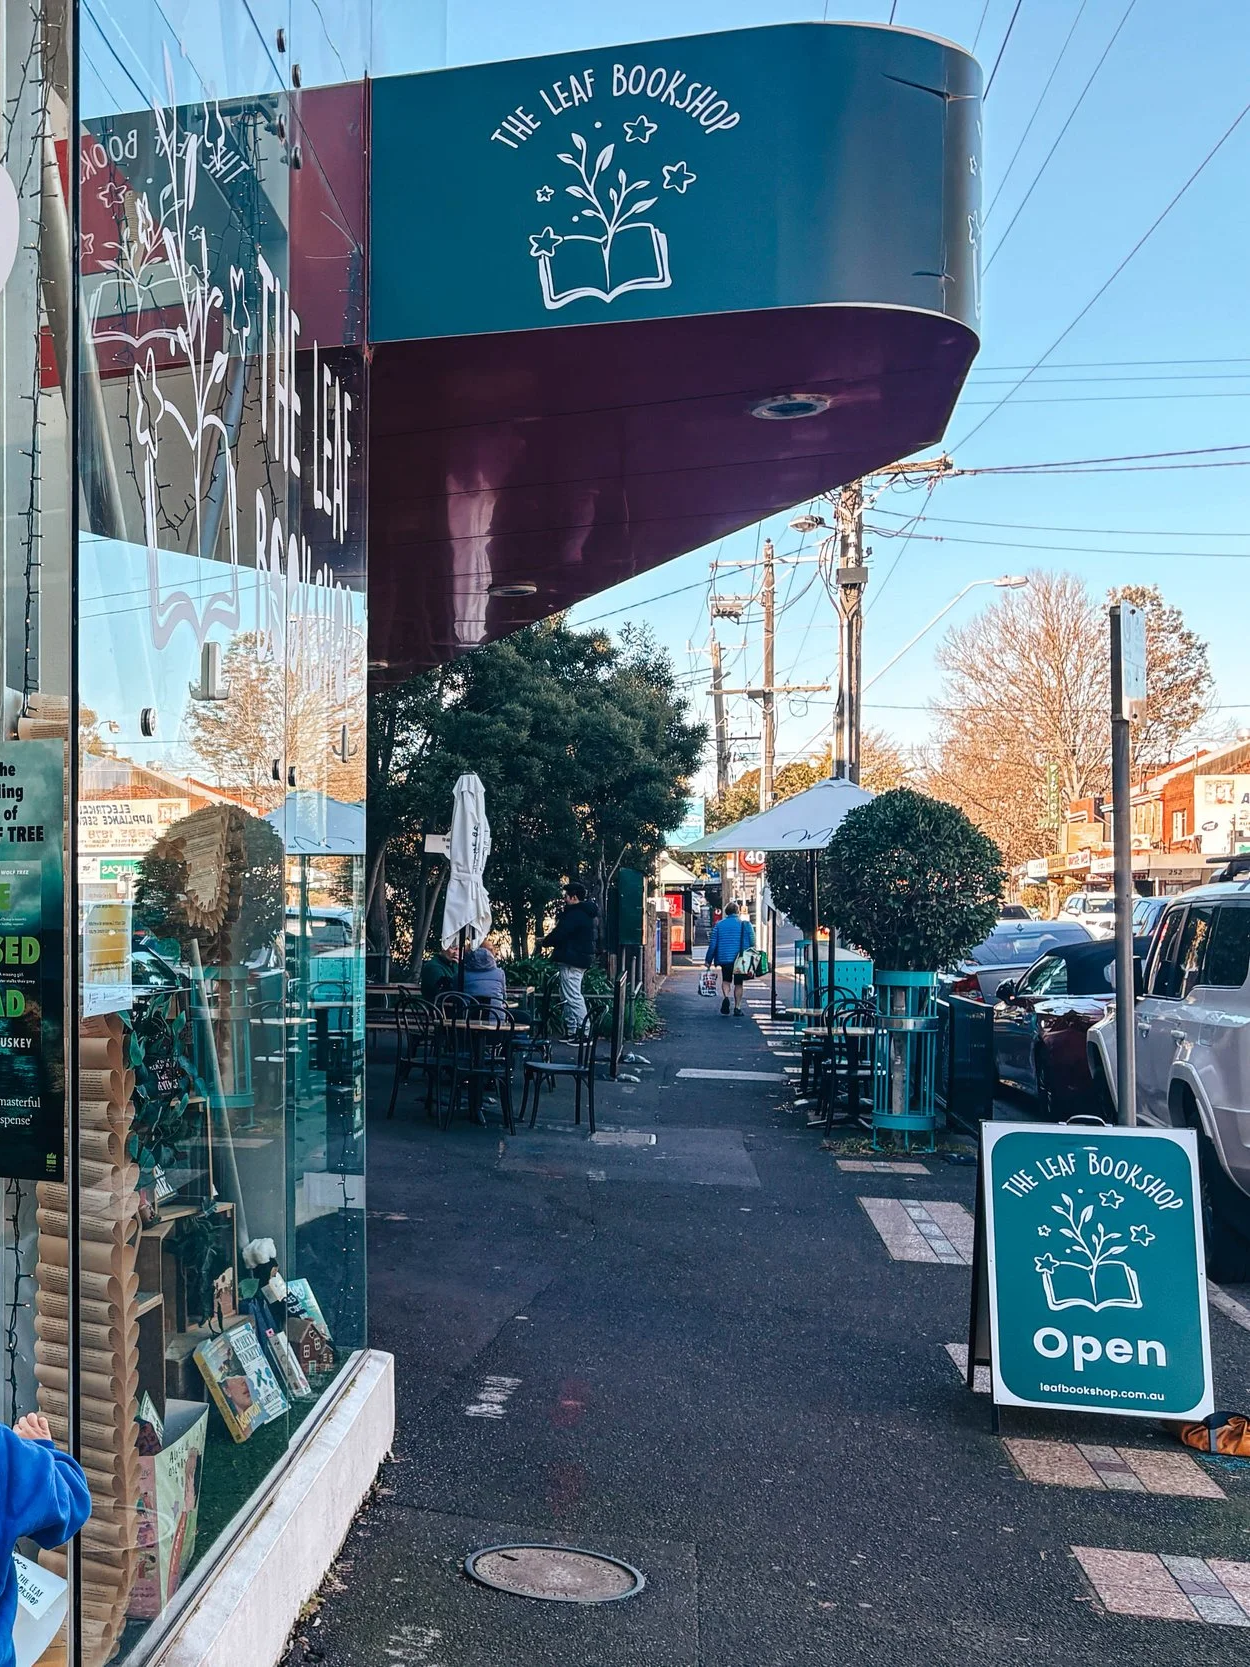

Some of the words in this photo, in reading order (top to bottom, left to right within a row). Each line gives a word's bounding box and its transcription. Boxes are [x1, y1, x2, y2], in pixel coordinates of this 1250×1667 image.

[491, 106, 541, 148] THE
[540, 69, 595, 116] LEAF
[613, 64, 740, 134] BOOKSHOP
[258, 254, 301, 478] THE
[313, 339, 352, 544] LEAF
[3, 805, 18, 820] of
[8, 825, 44, 842] TREE
[745, 851, 765, 864] 40
[1002, 1169, 1039, 1198] THE
[1036, 1153, 1076, 1180] LEAF
[1089, 1153, 1184, 1211] BOOKSHOP
[1033, 1327, 1166, 1371] Open
[1040, 1383, 1164, 1401] leafbookshop.com.au
[18, 1574, 29, 1585] THE
[31, 1583, 44, 1596] LEAF
